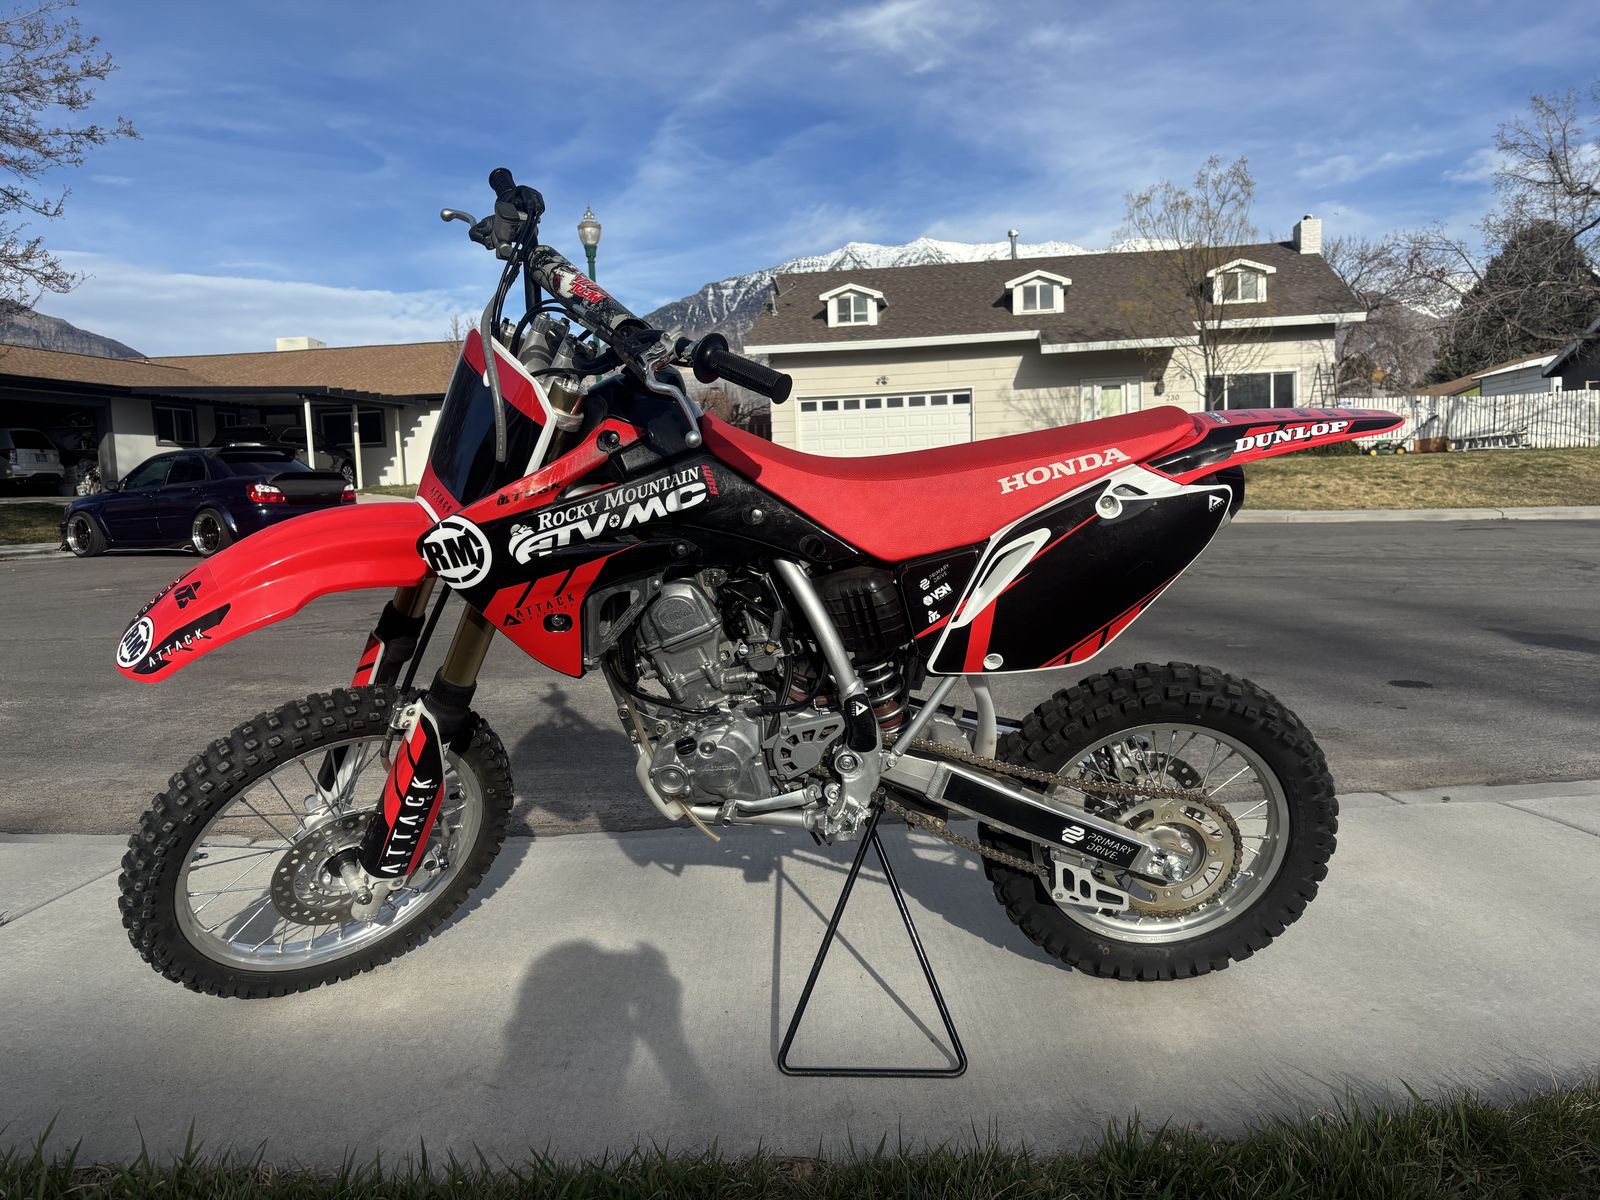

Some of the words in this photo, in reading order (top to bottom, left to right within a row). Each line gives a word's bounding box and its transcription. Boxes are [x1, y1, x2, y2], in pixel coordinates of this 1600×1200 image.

[1233, 420, 1349, 453] DUNLOP
[997, 447, 1131, 496] HONDA
[537, 499, 600, 532] ROCKY
[603, 466, 700, 511] MOUNTAIN
[514, 511, 611, 566] ATV
[619, 482, 707, 531] MC
[423, 534, 478, 572] RM
[515, 592, 575, 619] ATTACK
[930, 582, 953, 600] VSN
[148, 628, 204, 668] ATTACK
[380, 776, 433, 874] ATTACK
[1087, 832, 1134, 855] PRIMARY
